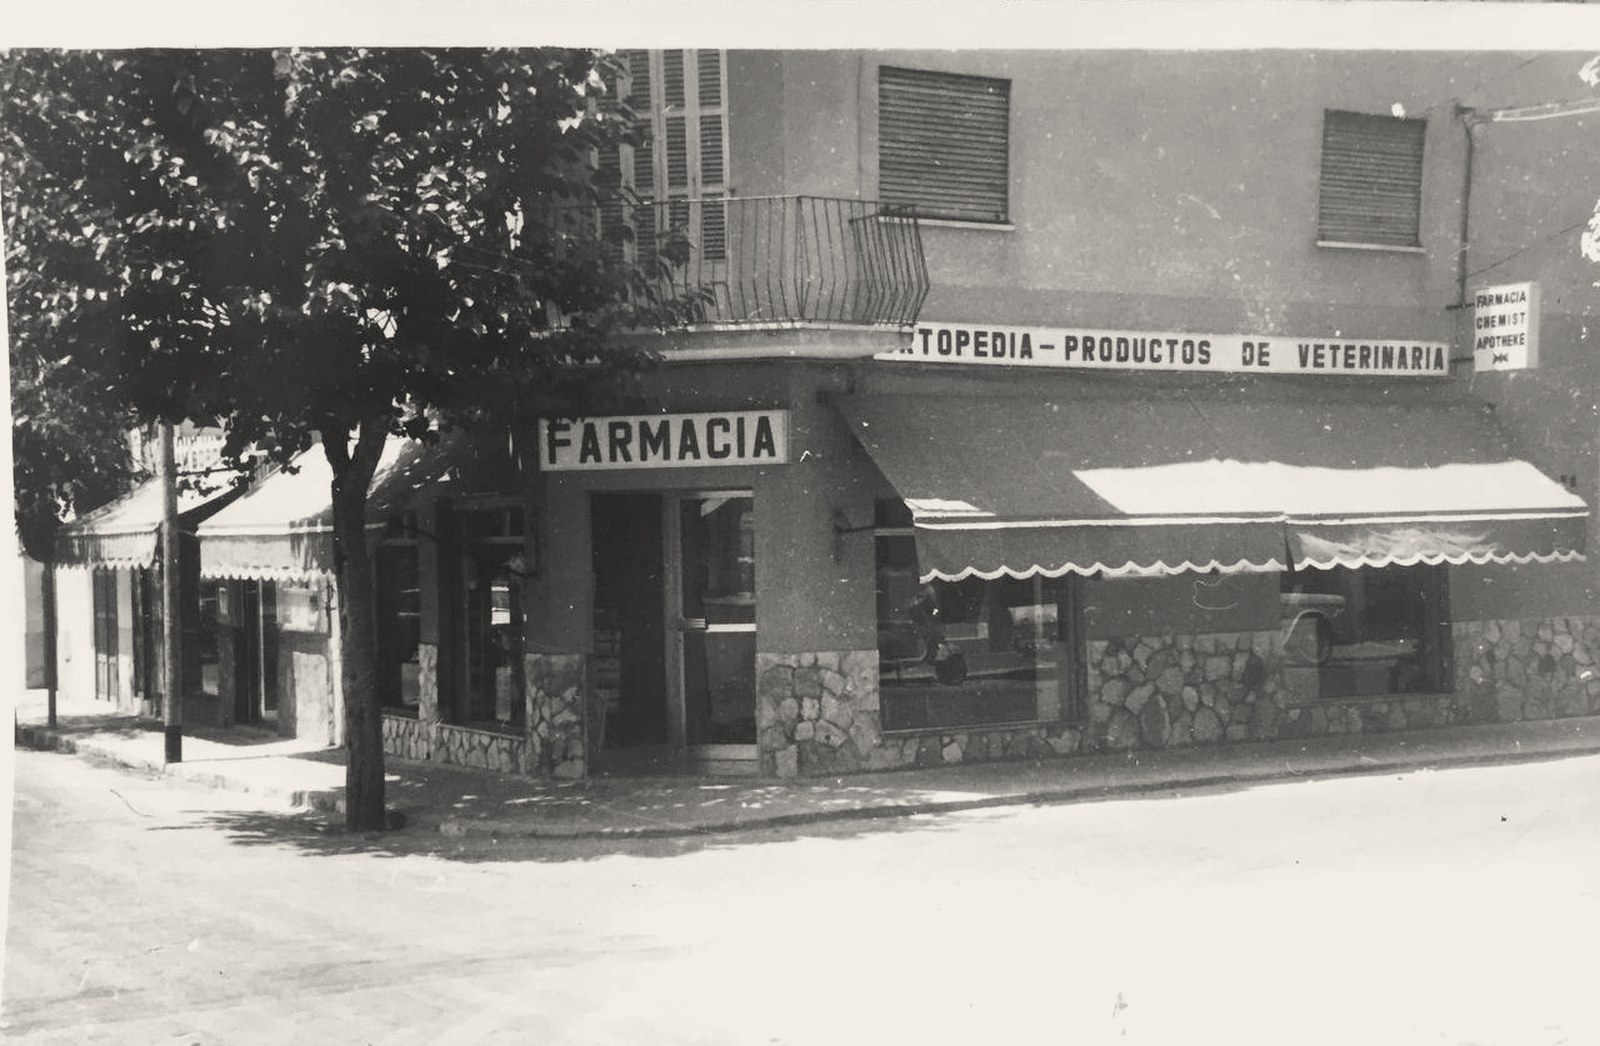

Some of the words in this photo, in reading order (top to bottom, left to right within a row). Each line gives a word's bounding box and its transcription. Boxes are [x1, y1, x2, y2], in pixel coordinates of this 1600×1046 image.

[1477, 291, 1526, 308] FARMACIA
[1476, 312, 1525, 329] CHEMIST
[888, 328, 1033, 359] TOPEDIA
[1064, 335, 1211, 364] PRODUCTOS
[1241, 341, 1271, 367] DE
[1298, 344, 1445, 370] VETERINARIA
[1477, 333, 1525, 350] APOTHEKE
[548, 416, 776, 464] FARMACIA
